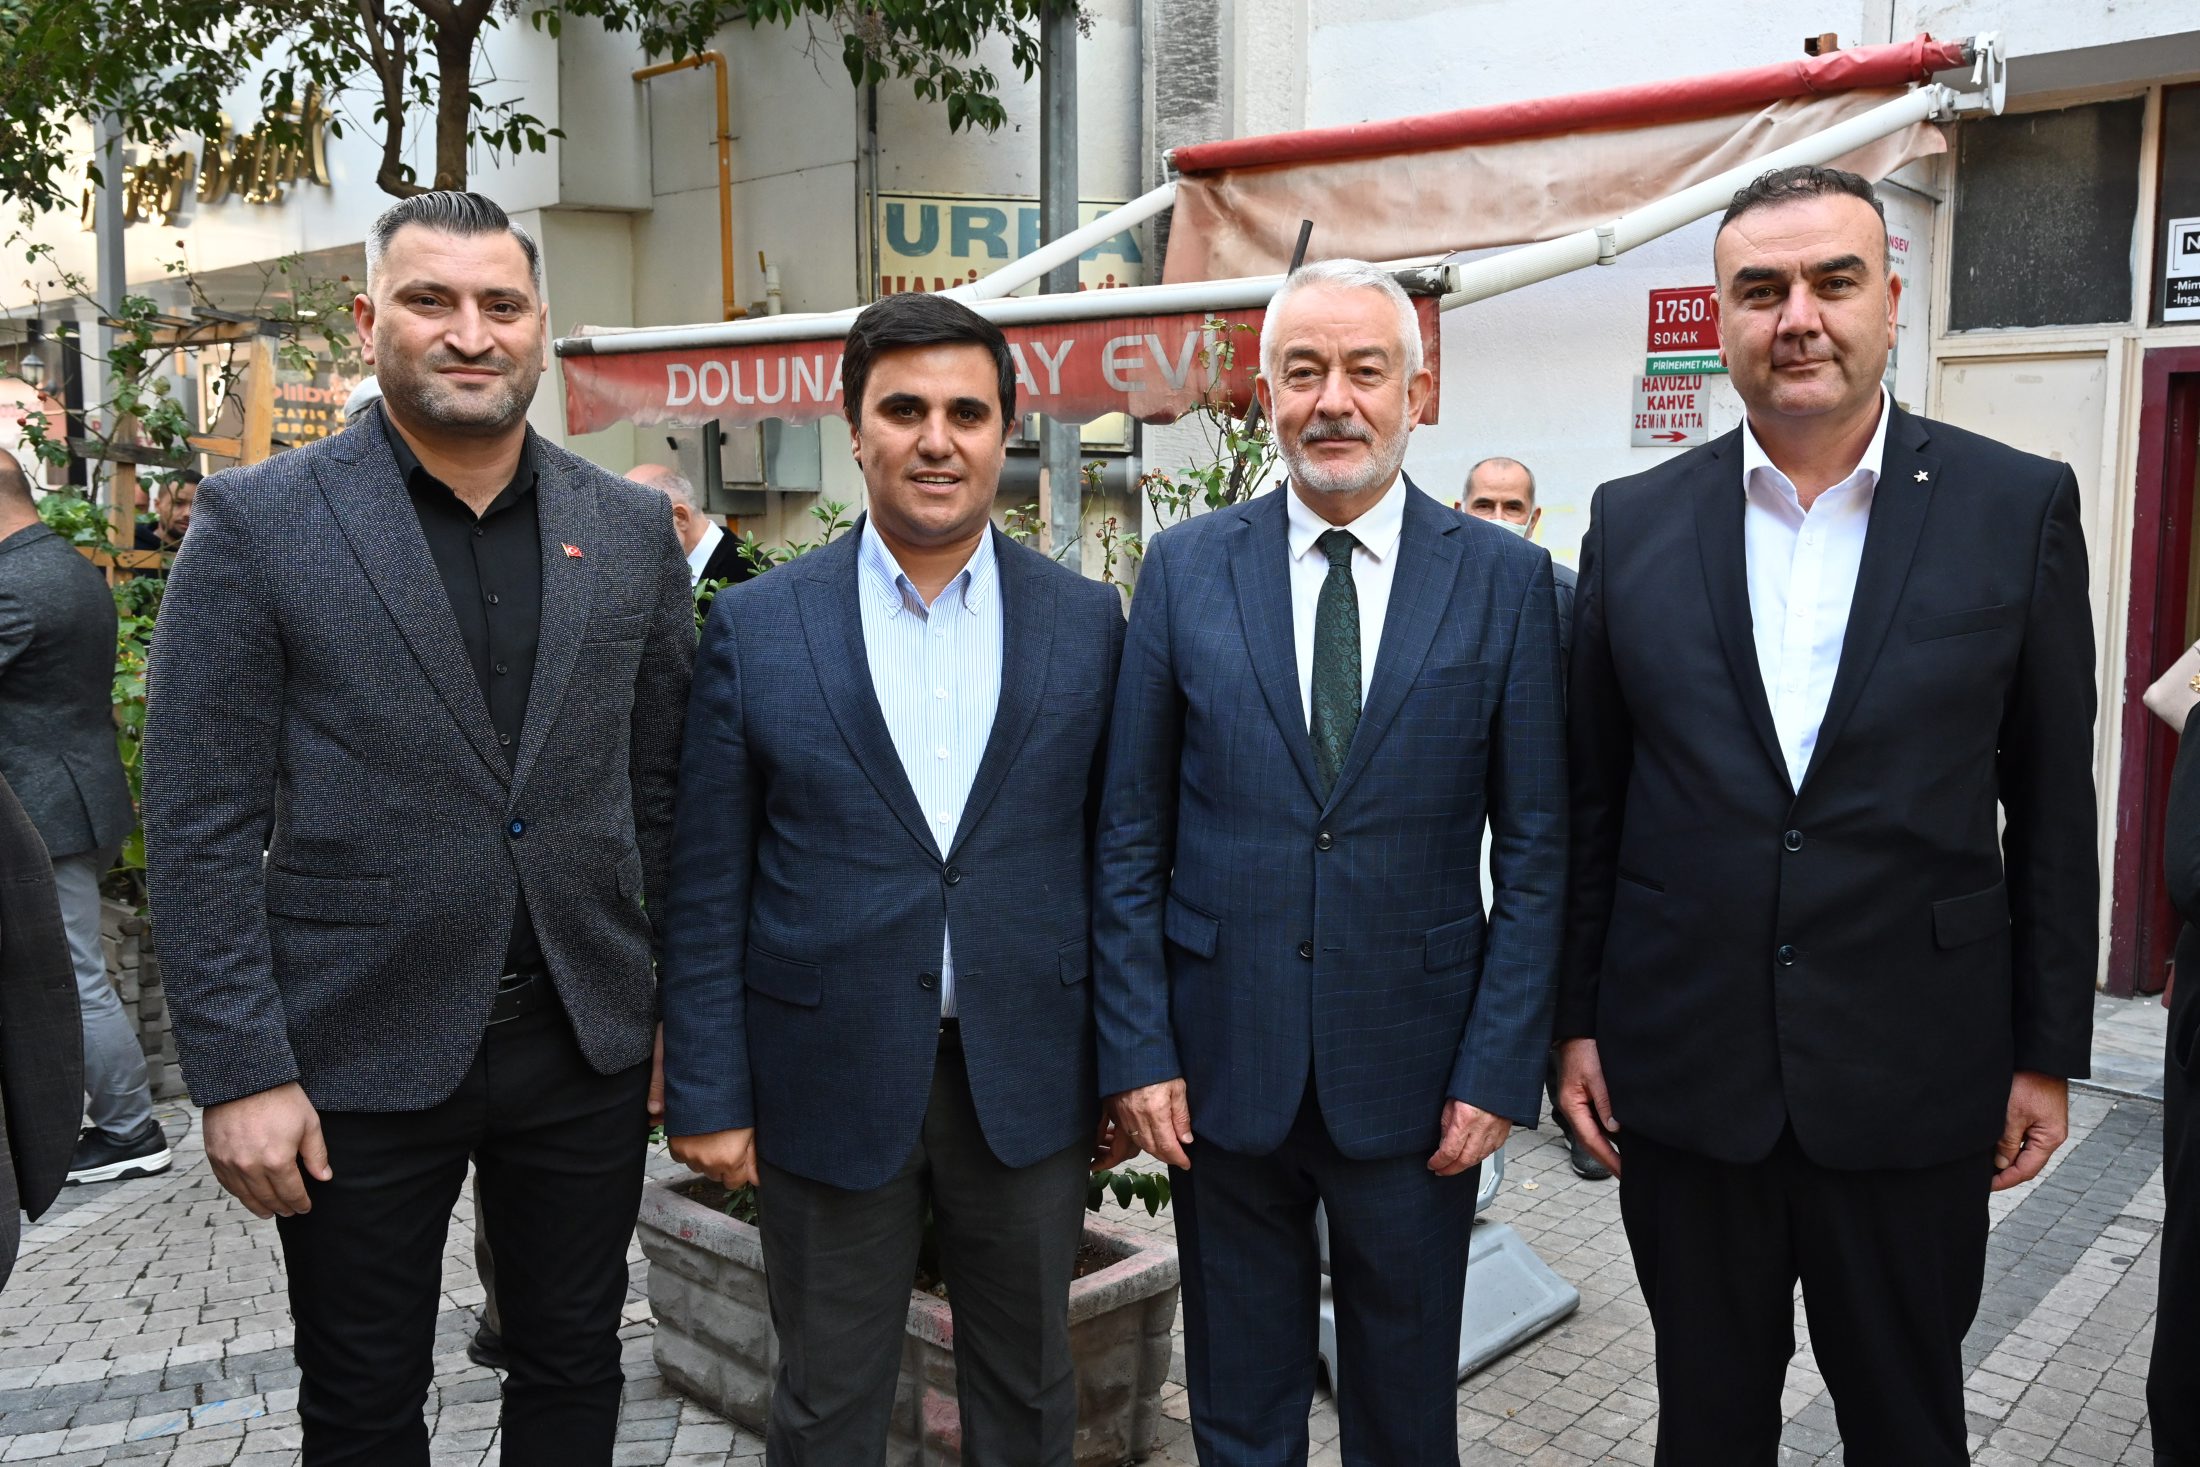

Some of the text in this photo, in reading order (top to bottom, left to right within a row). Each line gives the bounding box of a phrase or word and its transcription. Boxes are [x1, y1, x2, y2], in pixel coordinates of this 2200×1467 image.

[1655, 298, 1711, 323] 1750.
[1654, 331, 1698, 345] SOKAK
[1653, 360, 1701, 370] PİRİMEHMET
[1642, 374, 1702, 392] HAVUZLU
[1647, 394, 1695, 410] KAHVE
[1671, 412, 1703, 428] KATTA
